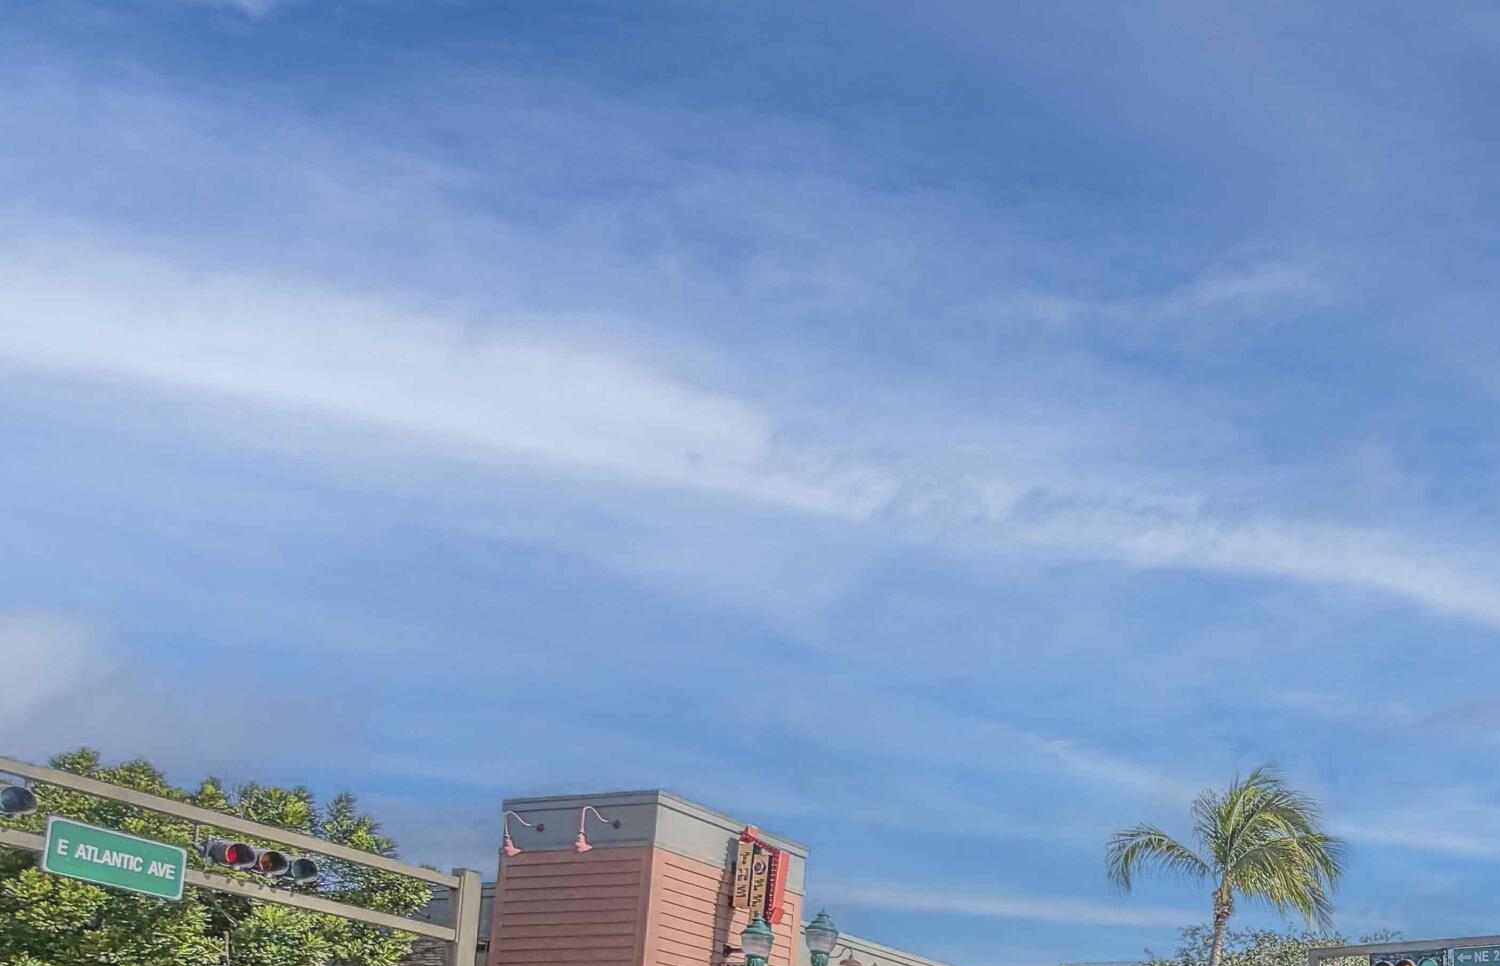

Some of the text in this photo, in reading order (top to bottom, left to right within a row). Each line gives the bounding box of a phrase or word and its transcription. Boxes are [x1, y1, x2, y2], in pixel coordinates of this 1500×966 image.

[57, 839, 176, 880] E ATLANTIC AVE
[1474, 950, 1490, 962] NE
[1493, 949, 1500, 961] 2
